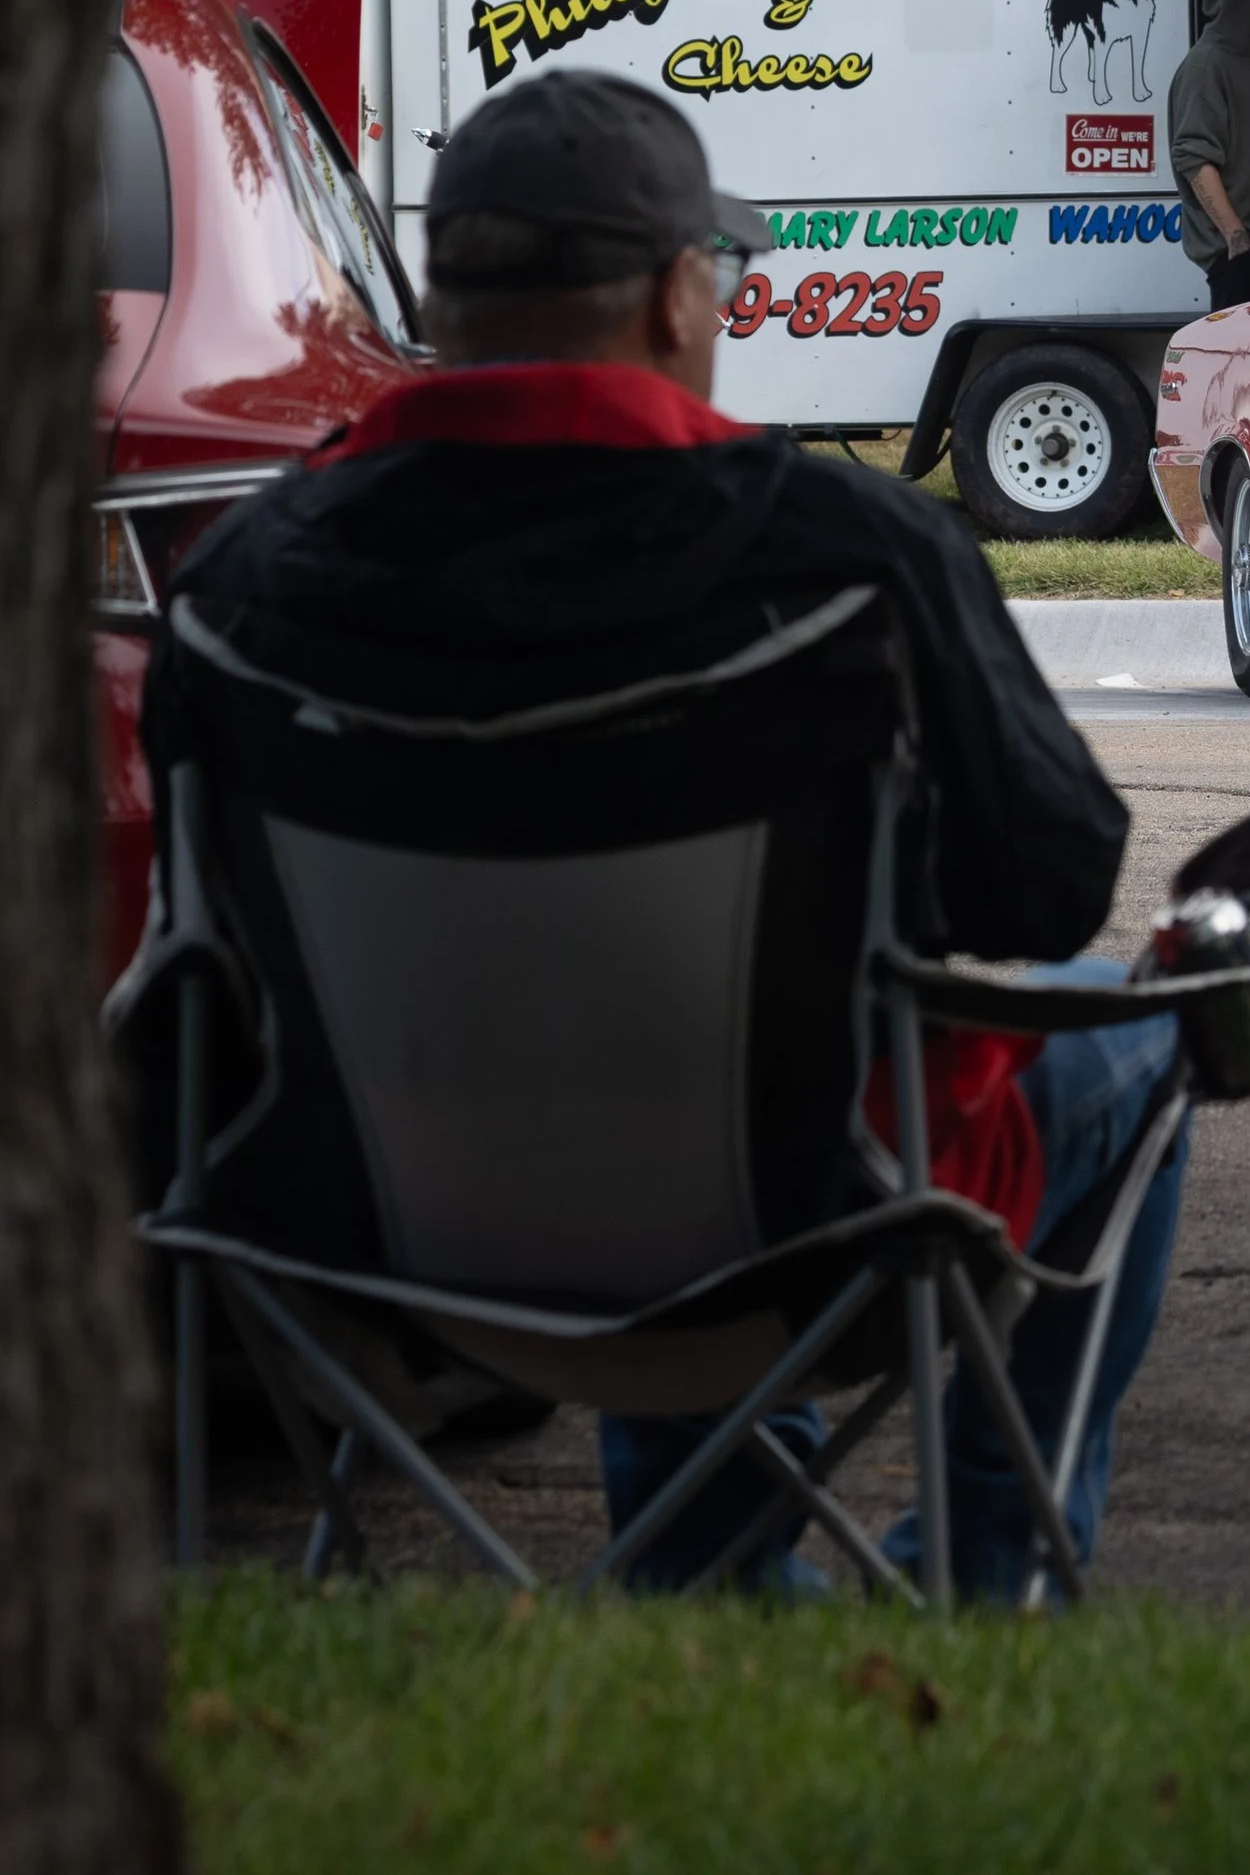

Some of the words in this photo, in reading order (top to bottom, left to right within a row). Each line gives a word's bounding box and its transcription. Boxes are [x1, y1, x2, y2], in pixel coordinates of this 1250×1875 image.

[662, 35, 873, 102] Cheese
[1071, 119, 1104, 138] Come
[1105, 125, 1118, 139] in
[1121, 131, 1149, 142] WE'RE
[1071, 147, 1149, 168] OPEN
[863, 207, 1018, 249] LARSON
[714, 270, 944, 339] 9-8235
